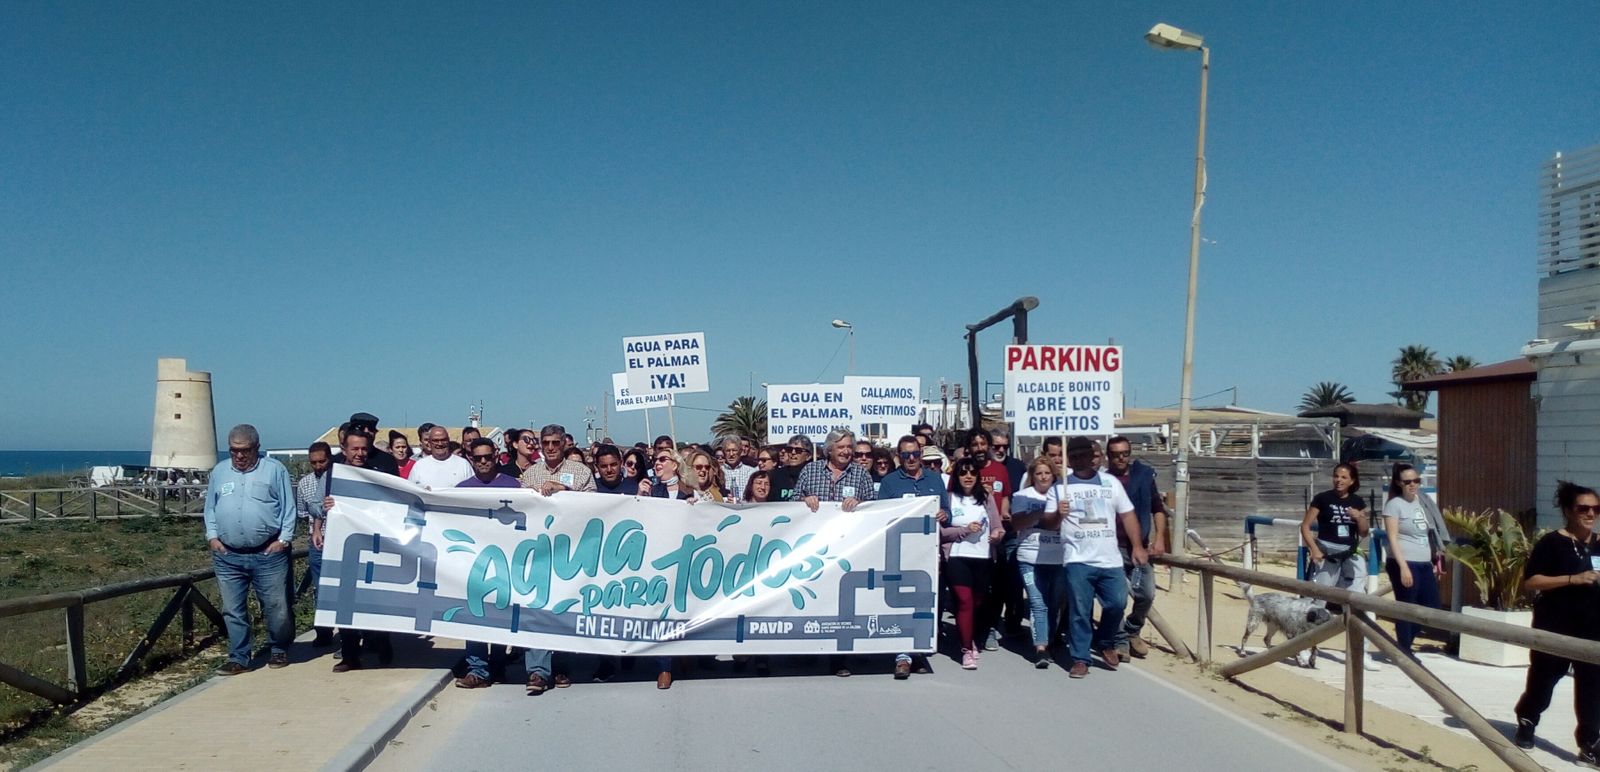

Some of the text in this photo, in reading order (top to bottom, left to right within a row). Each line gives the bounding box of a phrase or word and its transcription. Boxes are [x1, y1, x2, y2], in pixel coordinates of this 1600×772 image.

[627, 338, 699, 353] AGUA PARA
[629, 355, 700, 369] EL PALMAR
[1008, 346, 1119, 372] PARKING
[650, 373, 686, 389] ¡YA!
[1017, 381, 1110, 393] ALCALDE BONITO
[781, 392, 843, 403] AGUA EN
[861, 387, 916, 400] CALLAMOS,
[616, 398, 634, 406] PARA
[1027, 396, 1101, 411] ABRE LOS
[771, 408, 853, 420] EL PALMAR,
[860, 405, 916, 417] NSENTIMOS
[771, 425, 784, 434] NO
[787, 425, 828, 434] PEDIMOS
[1029, 416, 1100, 431] GRIFITOS
[1074, 489, 1098, 500] PALMAR
[467, 518, 647, 618] Agua
[575, 615, 686, 640] EN EL PALMAR
[750, 620, 794, 634] PAVIP
